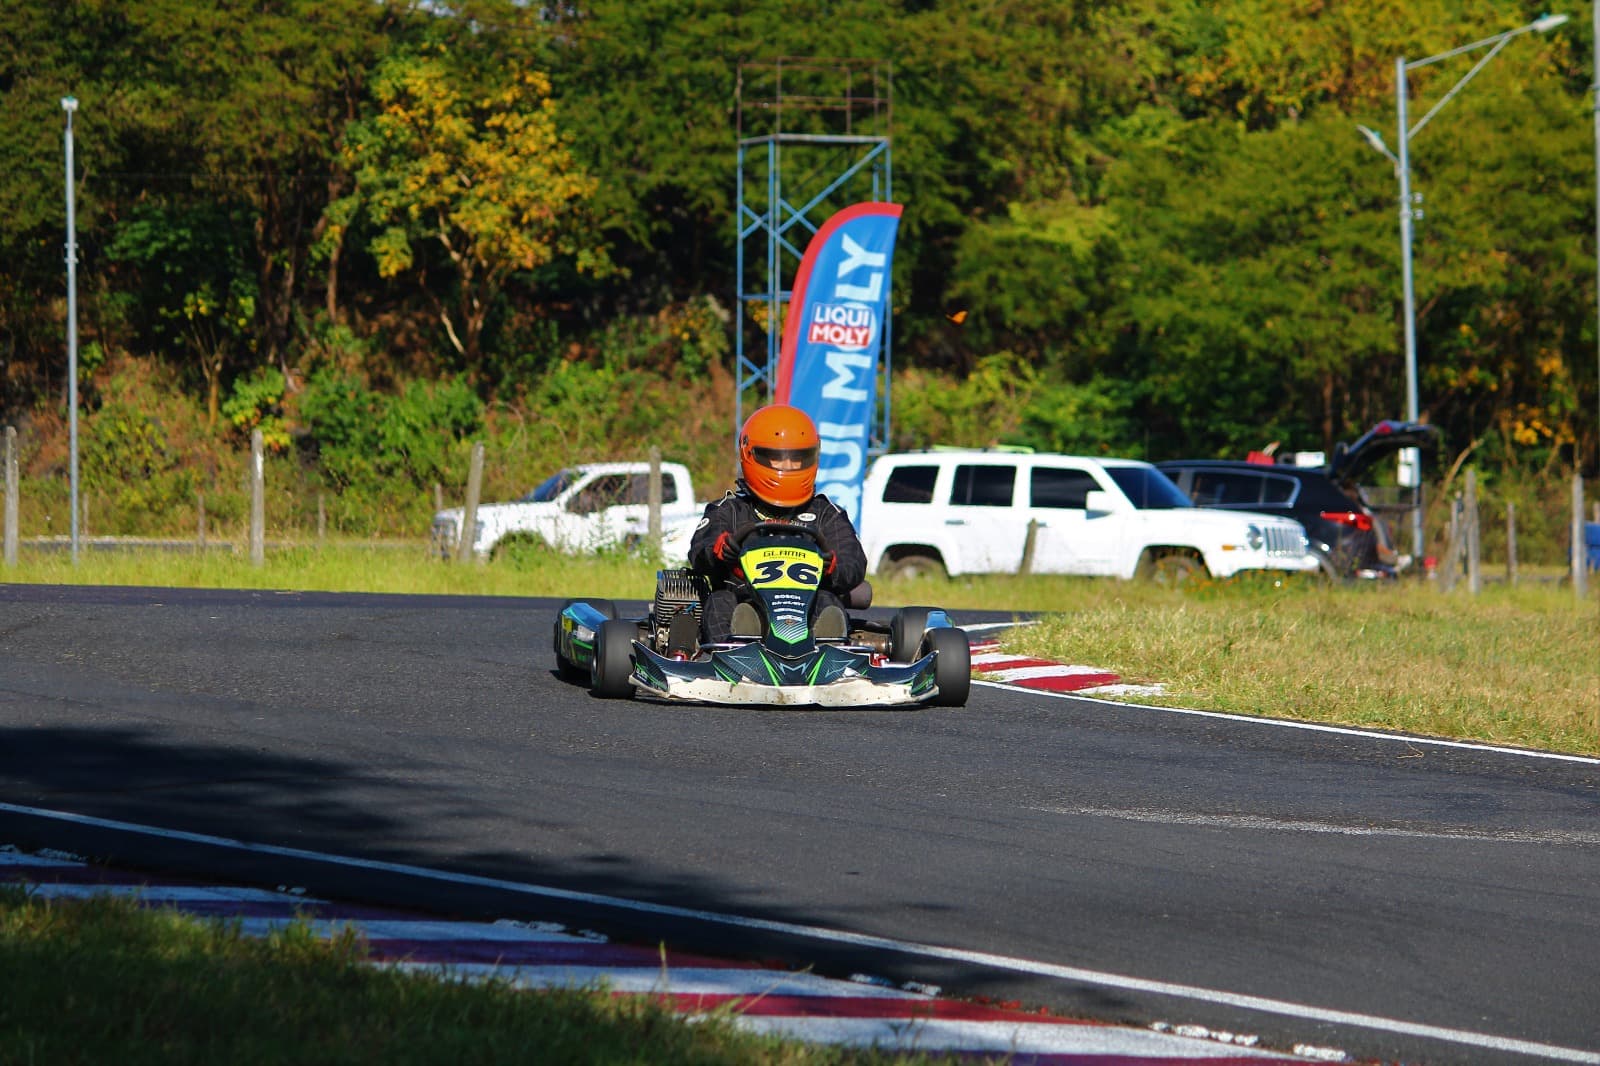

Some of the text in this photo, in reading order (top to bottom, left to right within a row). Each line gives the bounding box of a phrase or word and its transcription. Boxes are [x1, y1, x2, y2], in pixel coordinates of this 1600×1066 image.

[814, 305, 869, 327] LIQUI
[812, 325, 868, 344] MOLY
[815, 421, 864, 521] QUI
[752, 560, 819, 586] 36
